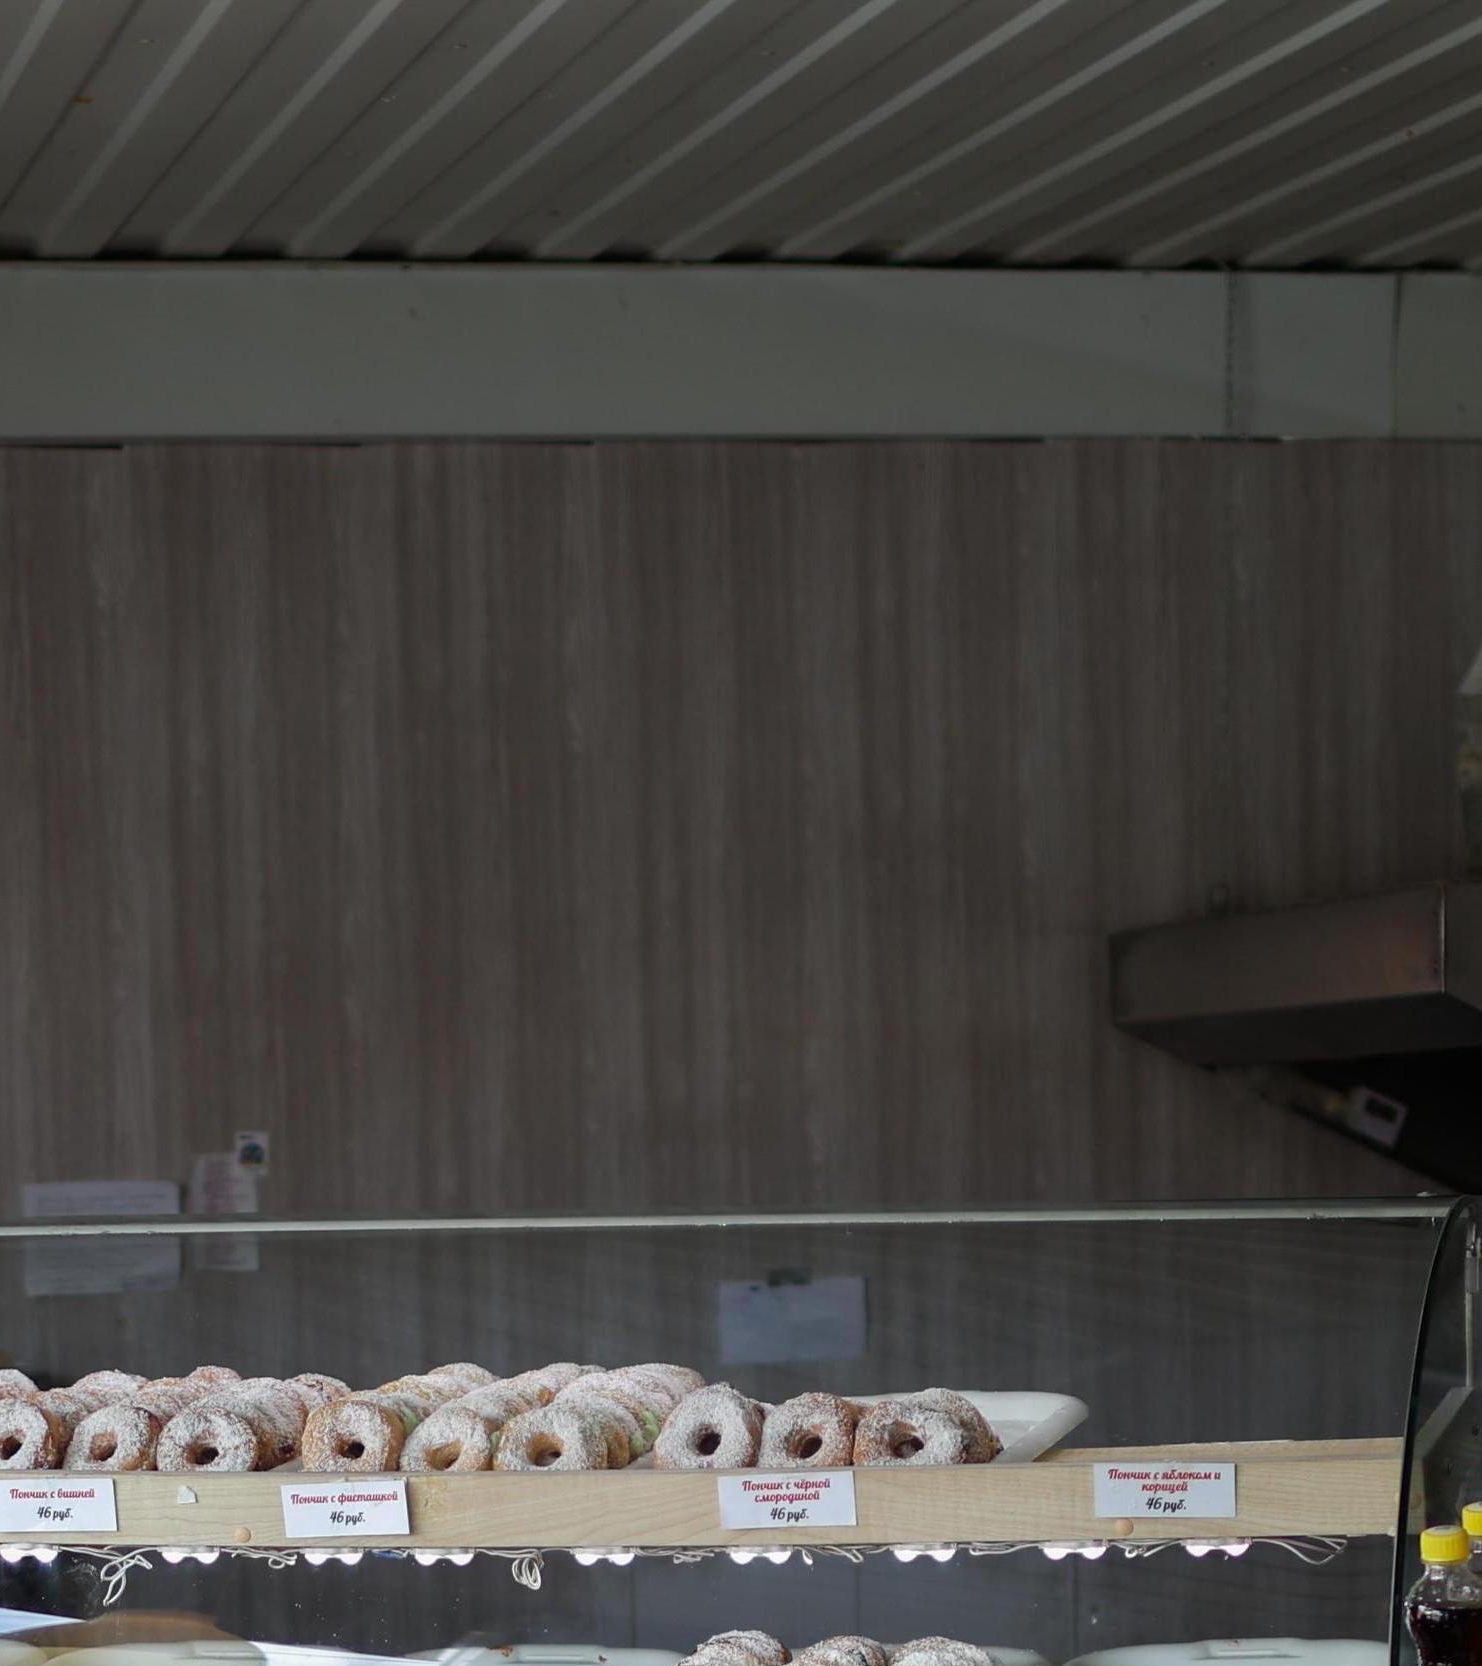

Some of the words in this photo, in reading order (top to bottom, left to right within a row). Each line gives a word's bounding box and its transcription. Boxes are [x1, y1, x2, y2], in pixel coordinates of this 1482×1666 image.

[1108, 1468, 1150, 1480] Пончик
[1153, 1472, 1160, 1480] с
[1161, 1470, 1211, 1481] яблоком
[742, 1480, 784, 1492] Пончик
[786, 1482, 792, 1490] с
[794, 1478, 831, 1491] чёрной
[1141, 1481, 1188, 1494] корицей
[9, 1488, 47, 1500] Пончик
[50, 1490, 56, 1499] с
[57, 1488, 95, 1499] вишней
[290, 1494, 328, 1505] Пончик
[338, 1491, 399, 1505] фисташкой
[754, 1490, 820, 1504] смородиной
[1145, 1497, 1161, 1510] 46
[1162, 1496, 1187, 1513] руб.
[37, 1506, 51, 1519] 46
[52, 1507, 73, 1522] руб.
[330, 1511, 344, 1524] 46
[345, 1510, 366, 1526] руб.
[770, 1507, 785, 1520] 46
[786, 1507, 809, 1523] руб.
